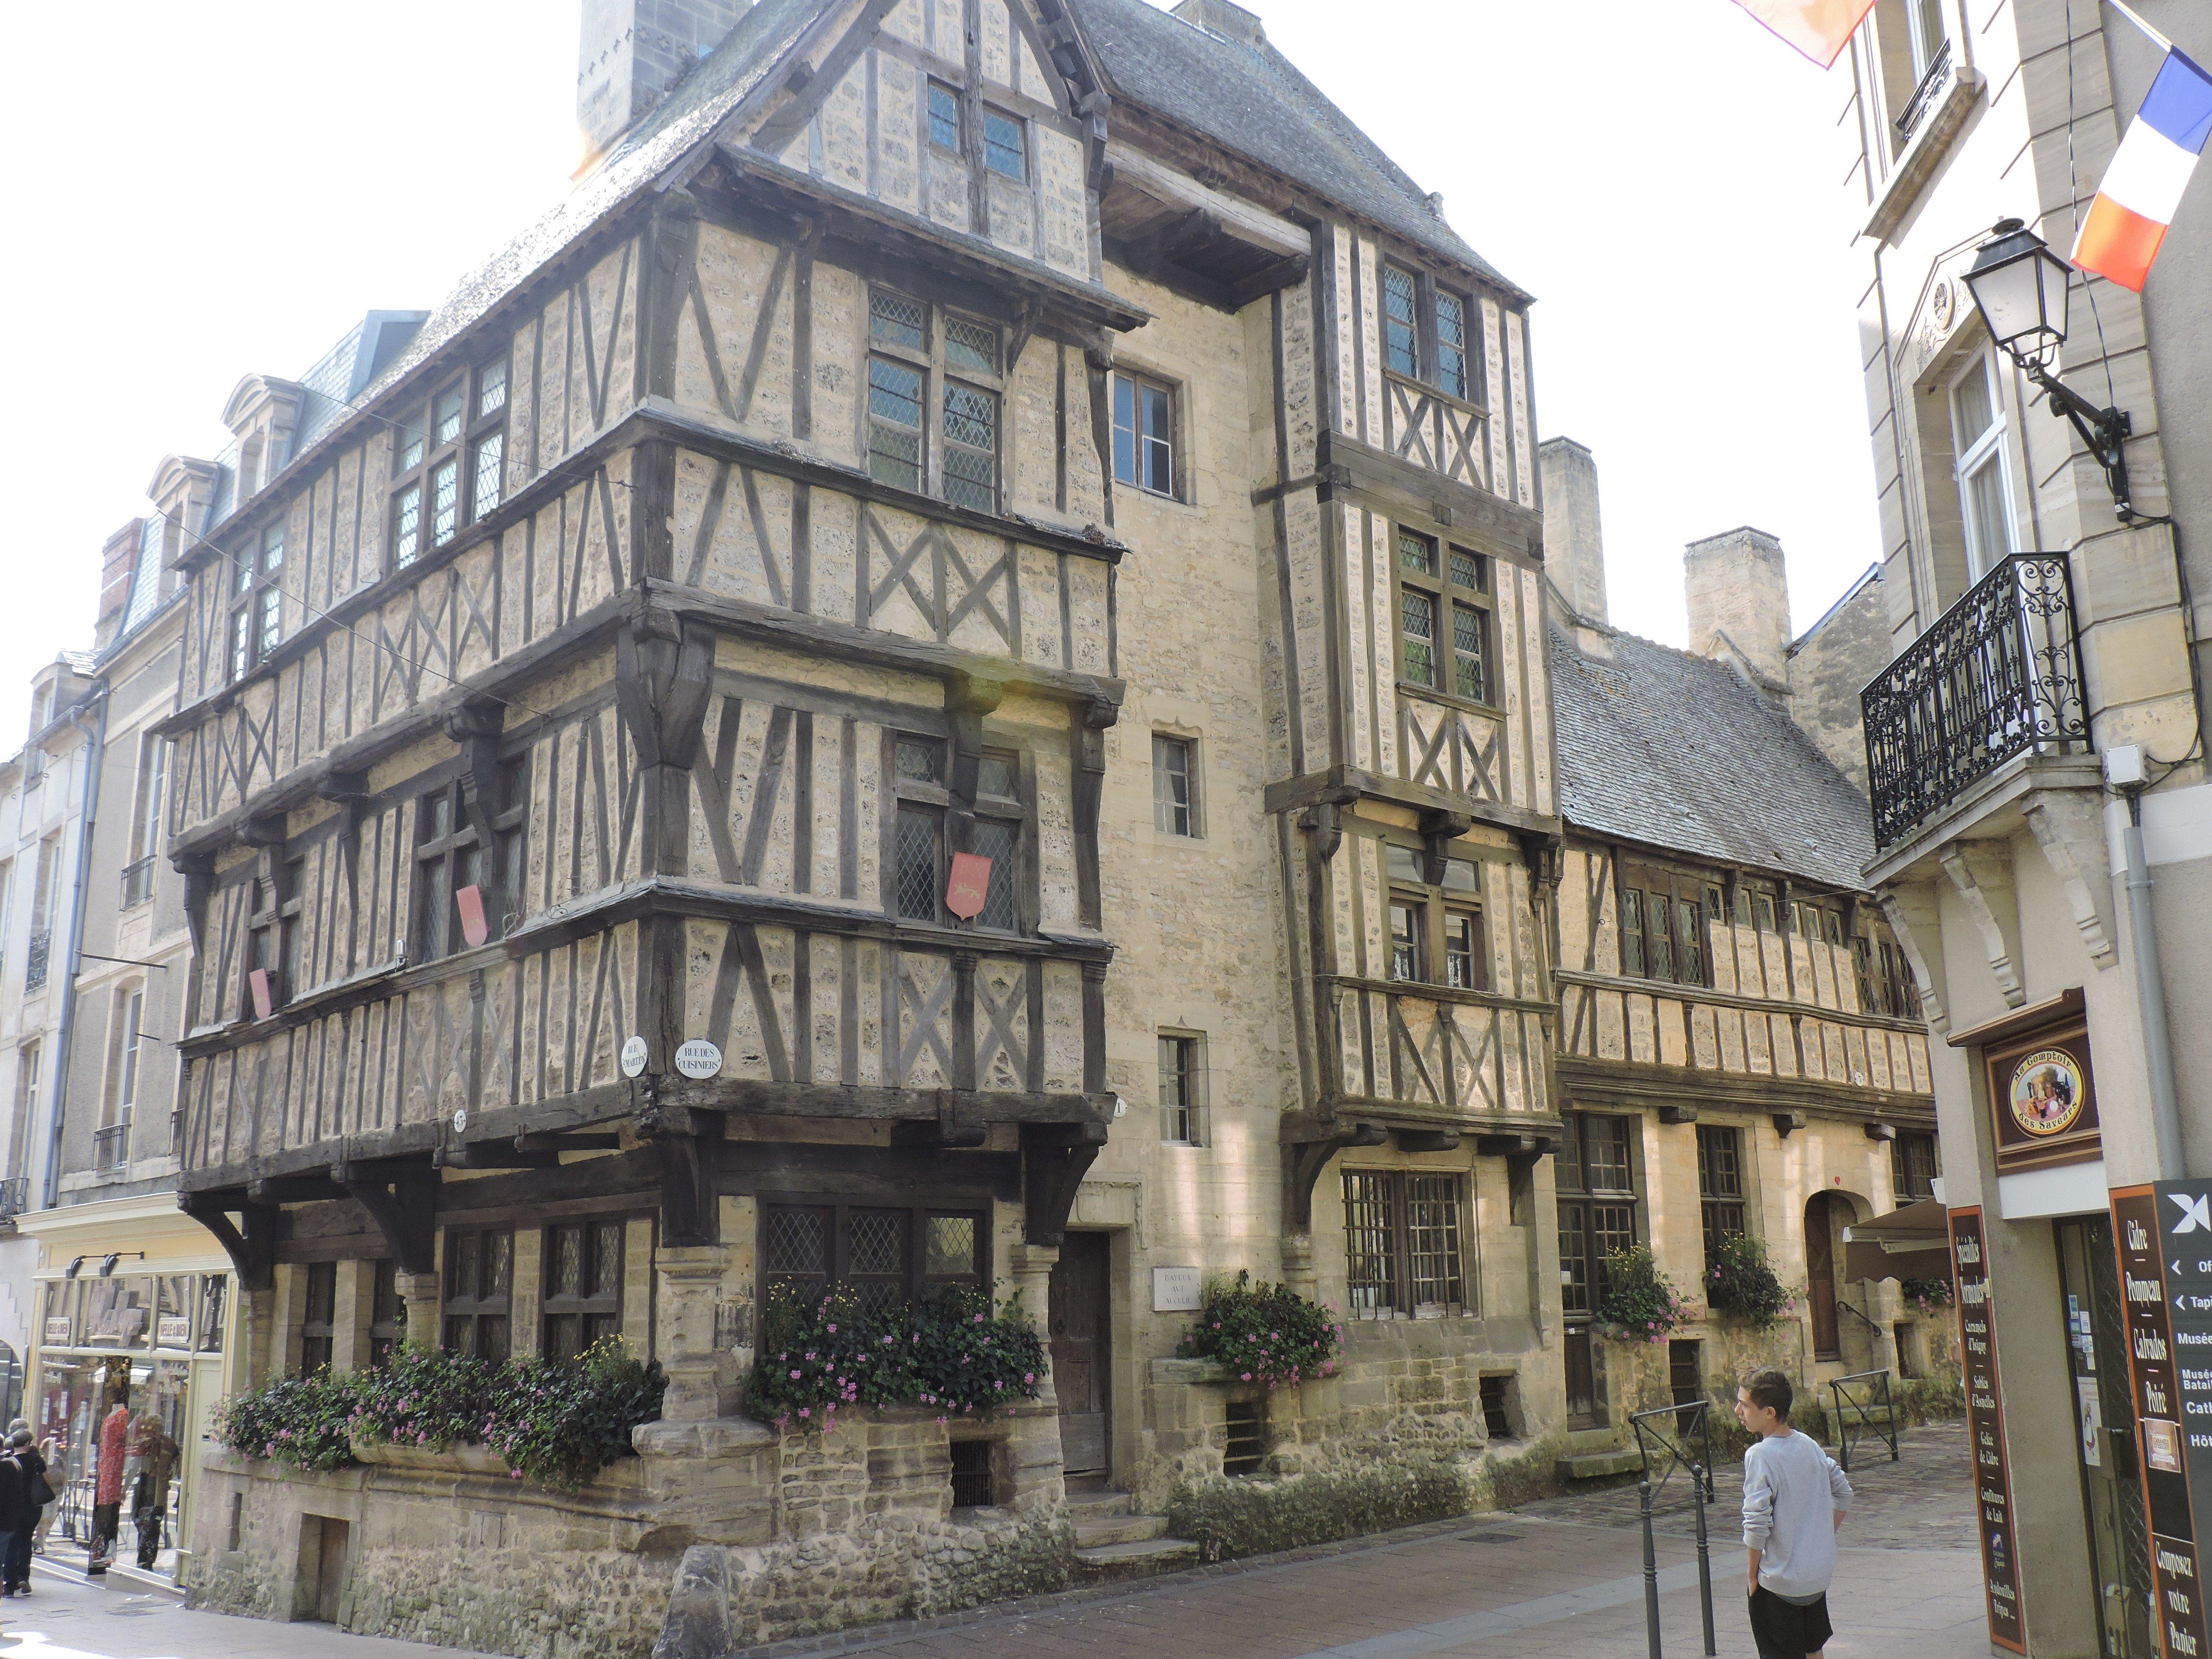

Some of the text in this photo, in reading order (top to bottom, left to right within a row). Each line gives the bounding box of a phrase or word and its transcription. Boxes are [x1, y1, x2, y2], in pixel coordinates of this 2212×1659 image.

[627, 1044, 637, 1054] RUE
[685, 1047, 714, 1057] RUE DES
[678, 1060, 718, 1070] CUISINIERS
[2015, 1051, 2072, 1082] Au Comptoir
[2019, 1100, 2078, 1130] des Saveurs
[2127, 1219, 2148, 1250] Cidre
[2126, 1271, 2162, 1308] Pommeau
[2134, 1328, 2167, 1361] Calvados
[2177, 1332, 2212, 1345] Musée
[2145, 1381, 2167, 1414] Poiré
[2156, 1540, 2193, 1579] Composez
[2168, 1588, 2189, 1614] votre
[2169, 1621, 2197, 1657] Panier
